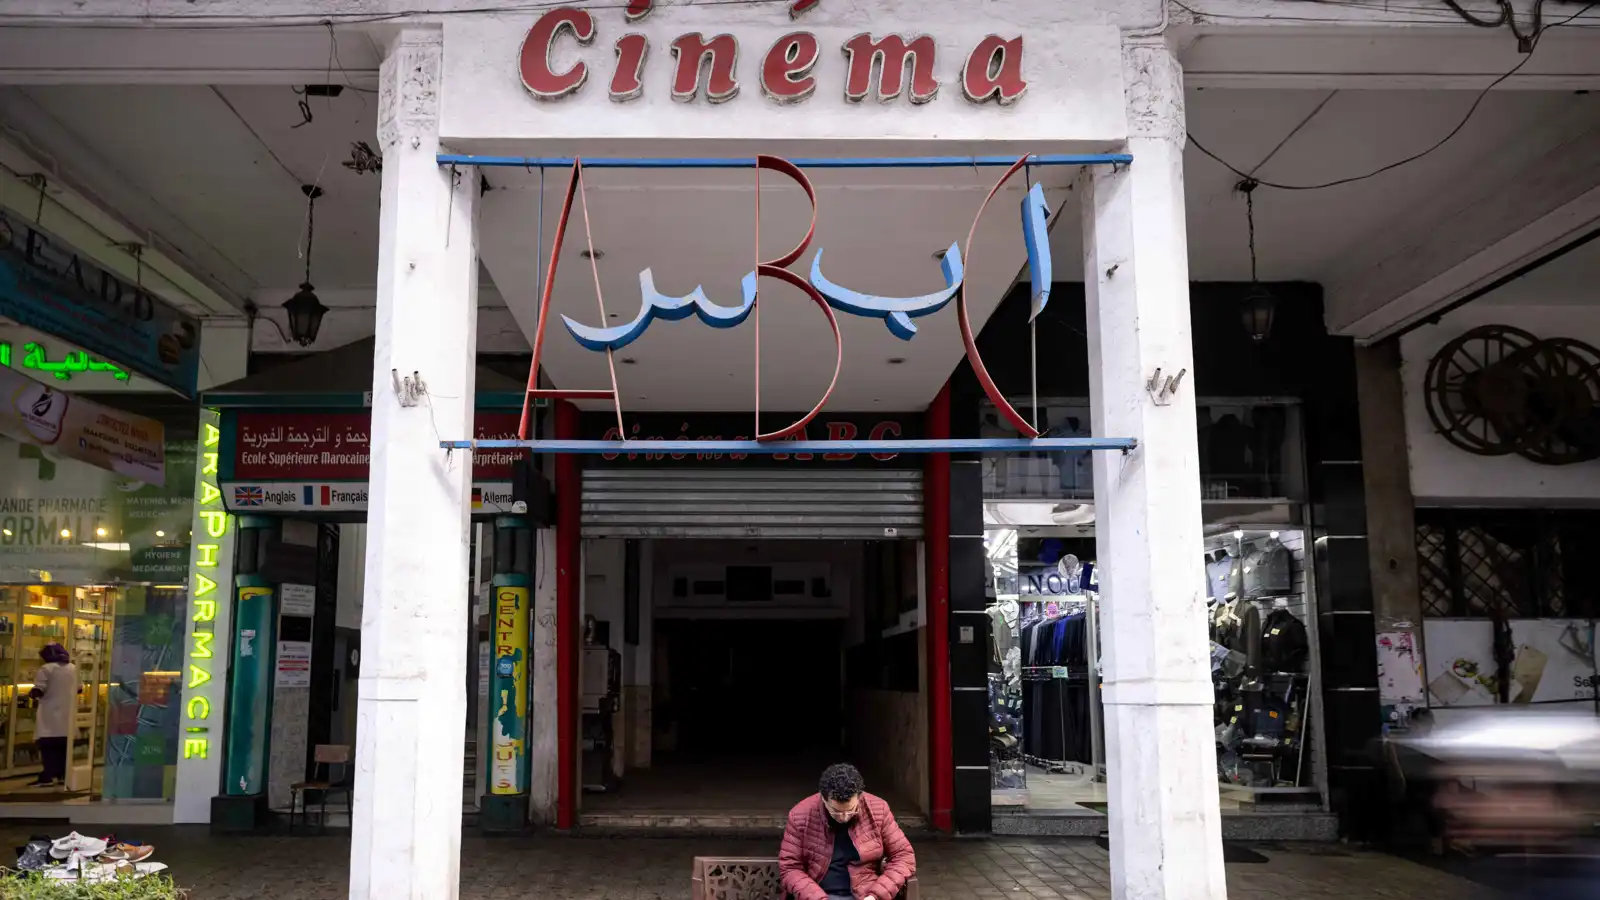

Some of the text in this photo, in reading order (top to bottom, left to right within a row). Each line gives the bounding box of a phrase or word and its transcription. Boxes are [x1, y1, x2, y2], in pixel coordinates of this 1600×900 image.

[518, 0, 1028, 105] Cinéma
[518, 154, 1040, 441] ABC
[242, 452, 268, 465] Ecole
[268, 452, 318, 468] Supérieure
[321, 452, 370, 465] Marocaine
[264, 491, 296, 504] Anglais
[331, 490, 369, 504] Français
[484, 491, 513, 504] Allema
[0, 499, 107, 513] ANDE PHARMACIE
[184, 406, 226, 759] ARAPHARMACIE
[1027, 573, 1080, 594] NOU
